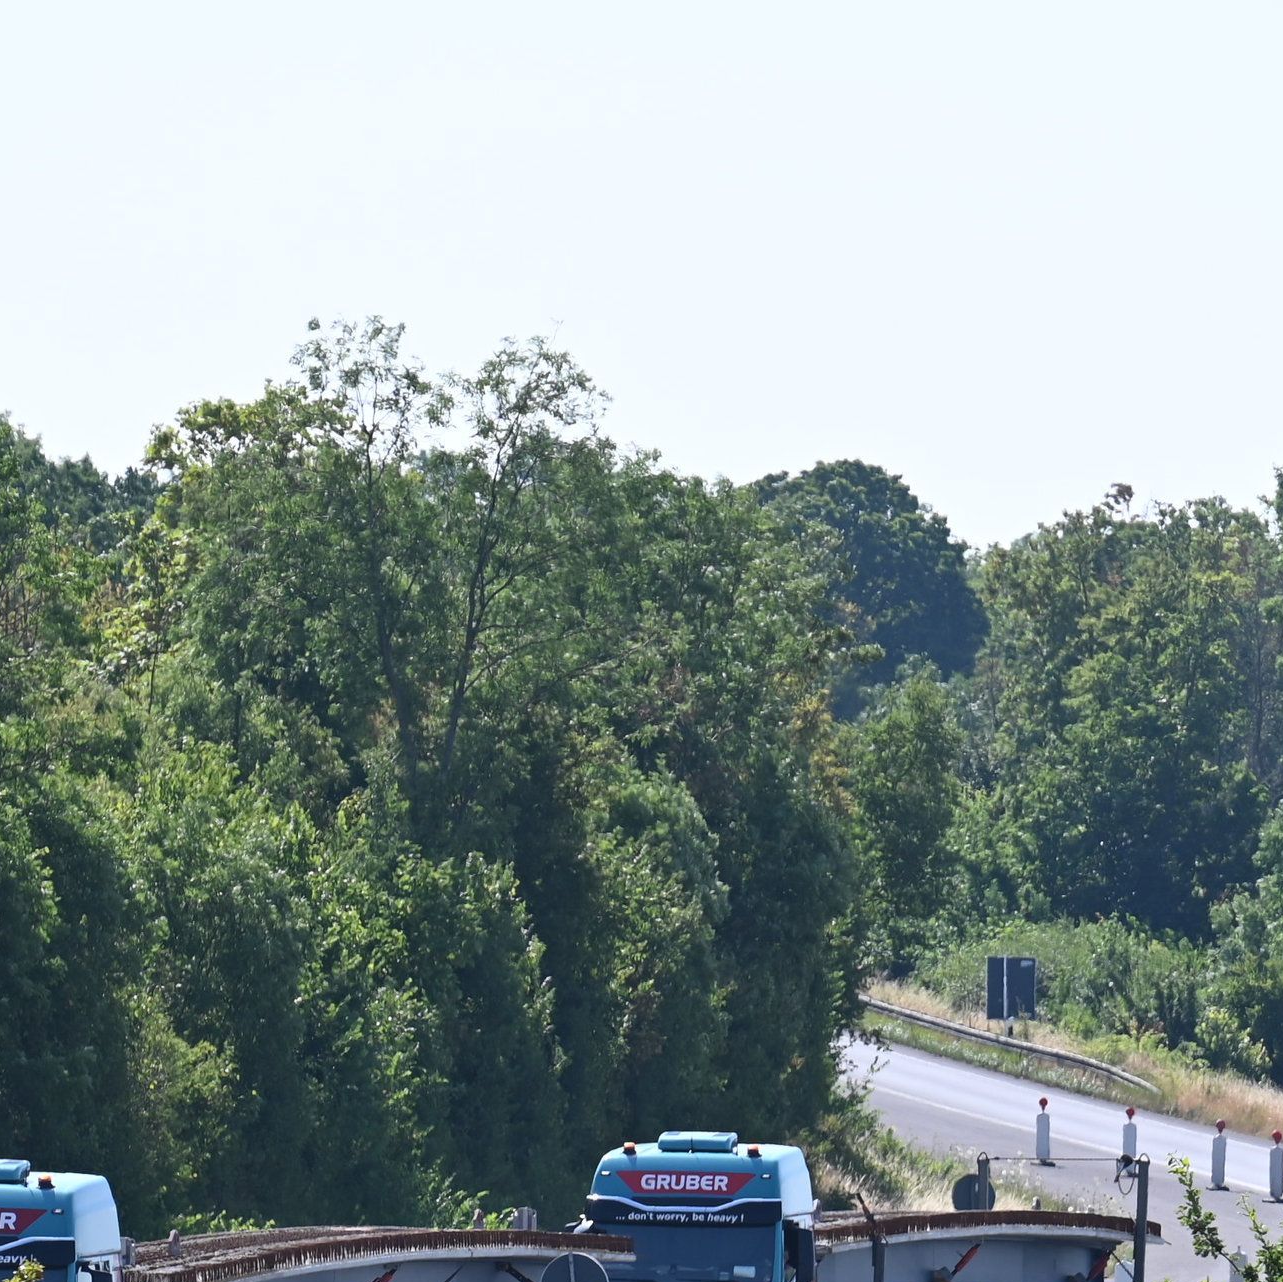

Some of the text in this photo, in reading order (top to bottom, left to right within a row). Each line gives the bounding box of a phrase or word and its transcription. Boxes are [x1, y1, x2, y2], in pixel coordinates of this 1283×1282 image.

[640, 1173, 729, 1191] GRUBER
[628, 1211, 654, 1221] don't
[656, 1213, 689, 1223] worry,
[692, 1212, 704, 1221] be
[707, 1212, 738, 1223] heavy
